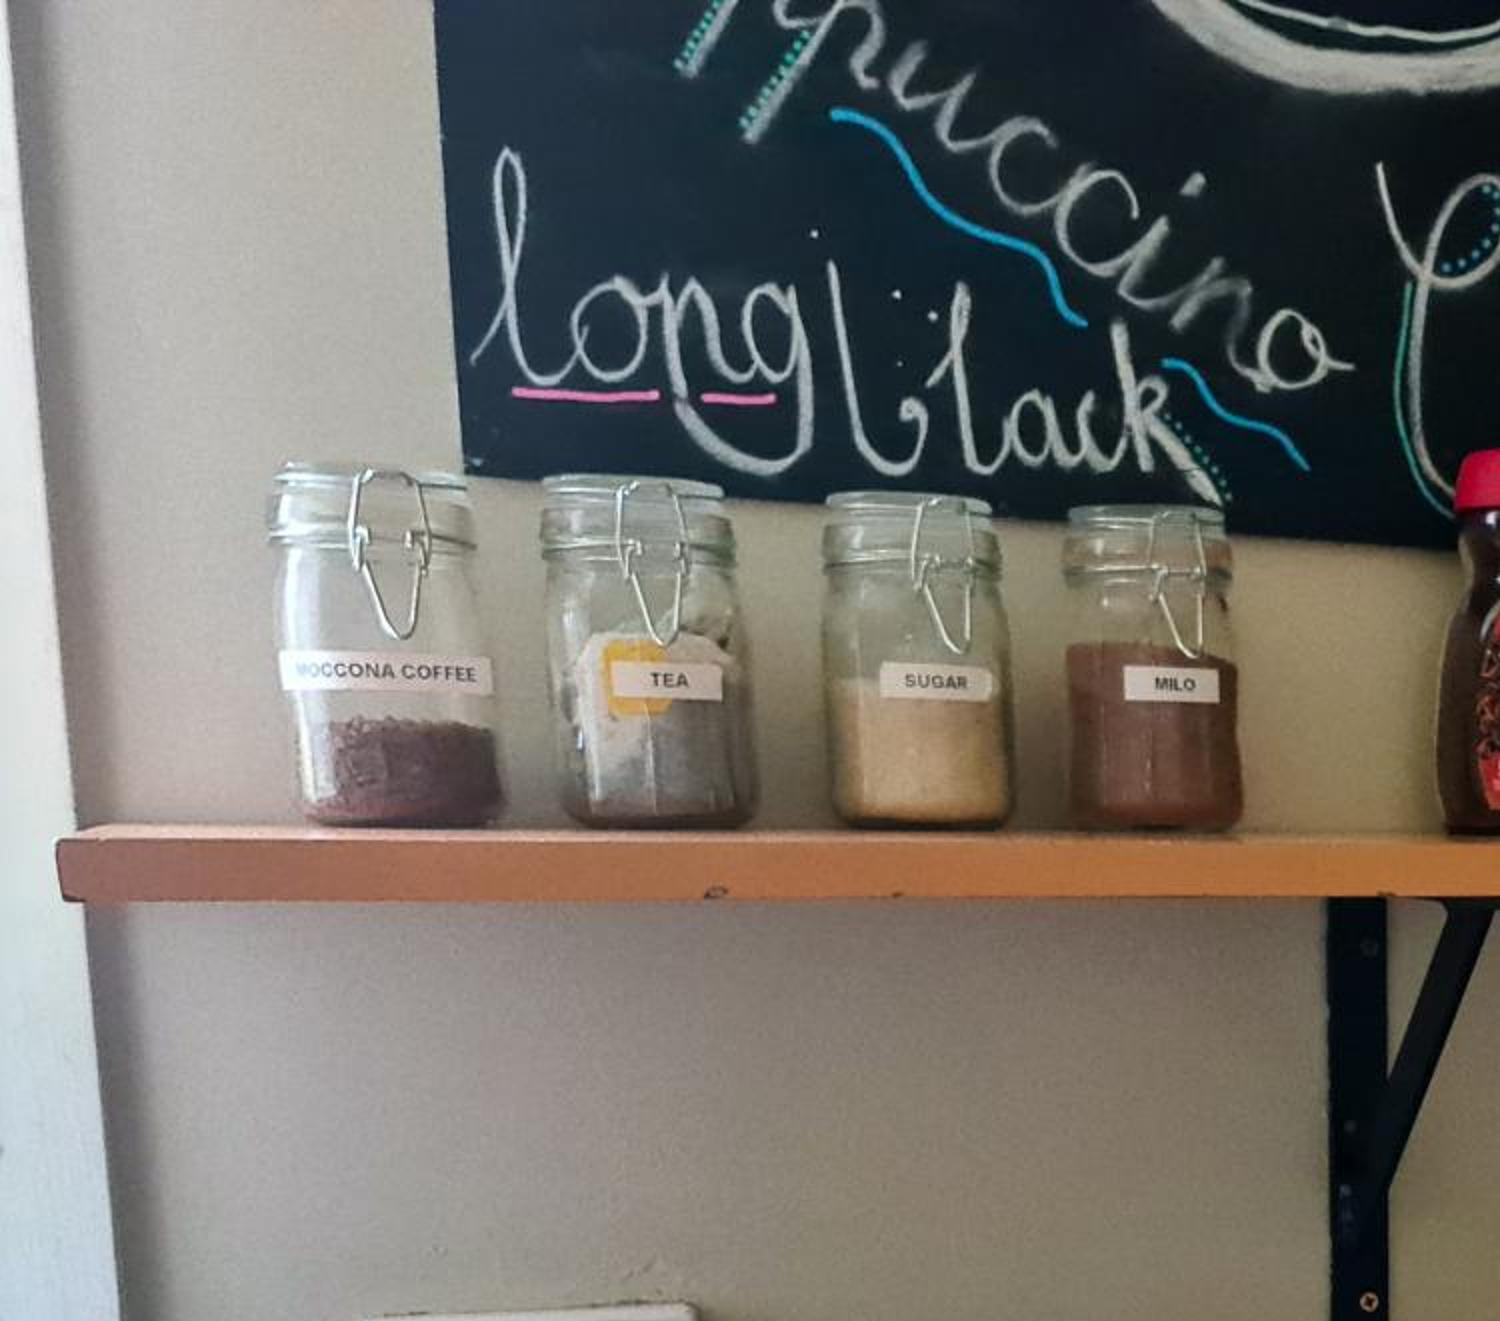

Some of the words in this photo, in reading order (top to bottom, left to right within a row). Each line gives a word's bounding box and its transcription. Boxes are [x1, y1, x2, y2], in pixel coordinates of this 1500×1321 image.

[401, 664, 478, 683] COFFEE
[651, 671, 690, 689] TEA
[904, 672, 968, 690] SUGAR
[1154, 676, 1197, 693] MILO
